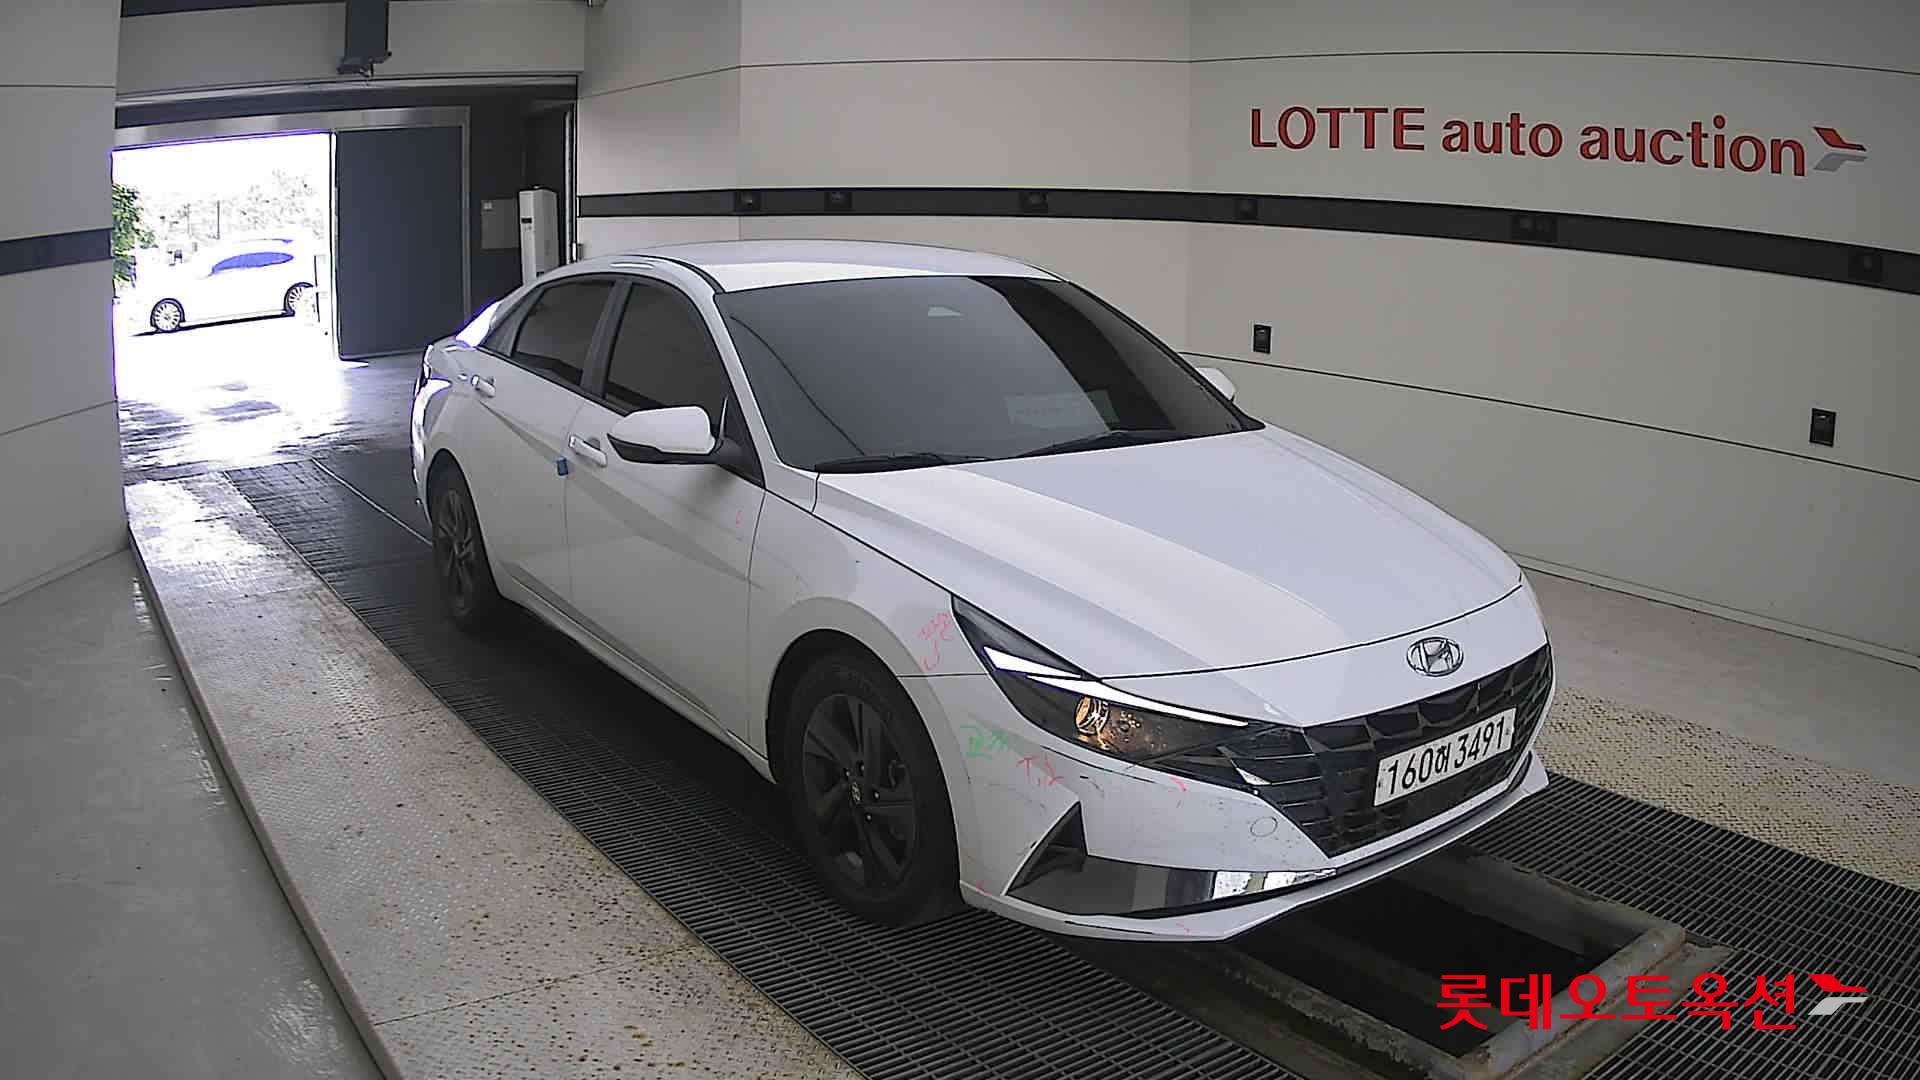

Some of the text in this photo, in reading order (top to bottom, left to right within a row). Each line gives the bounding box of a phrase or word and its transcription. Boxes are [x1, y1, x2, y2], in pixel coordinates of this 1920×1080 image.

[1250, 106, 1807, 176] LOTTE auto auction
[1454, 716, 1505, 769] 3491
